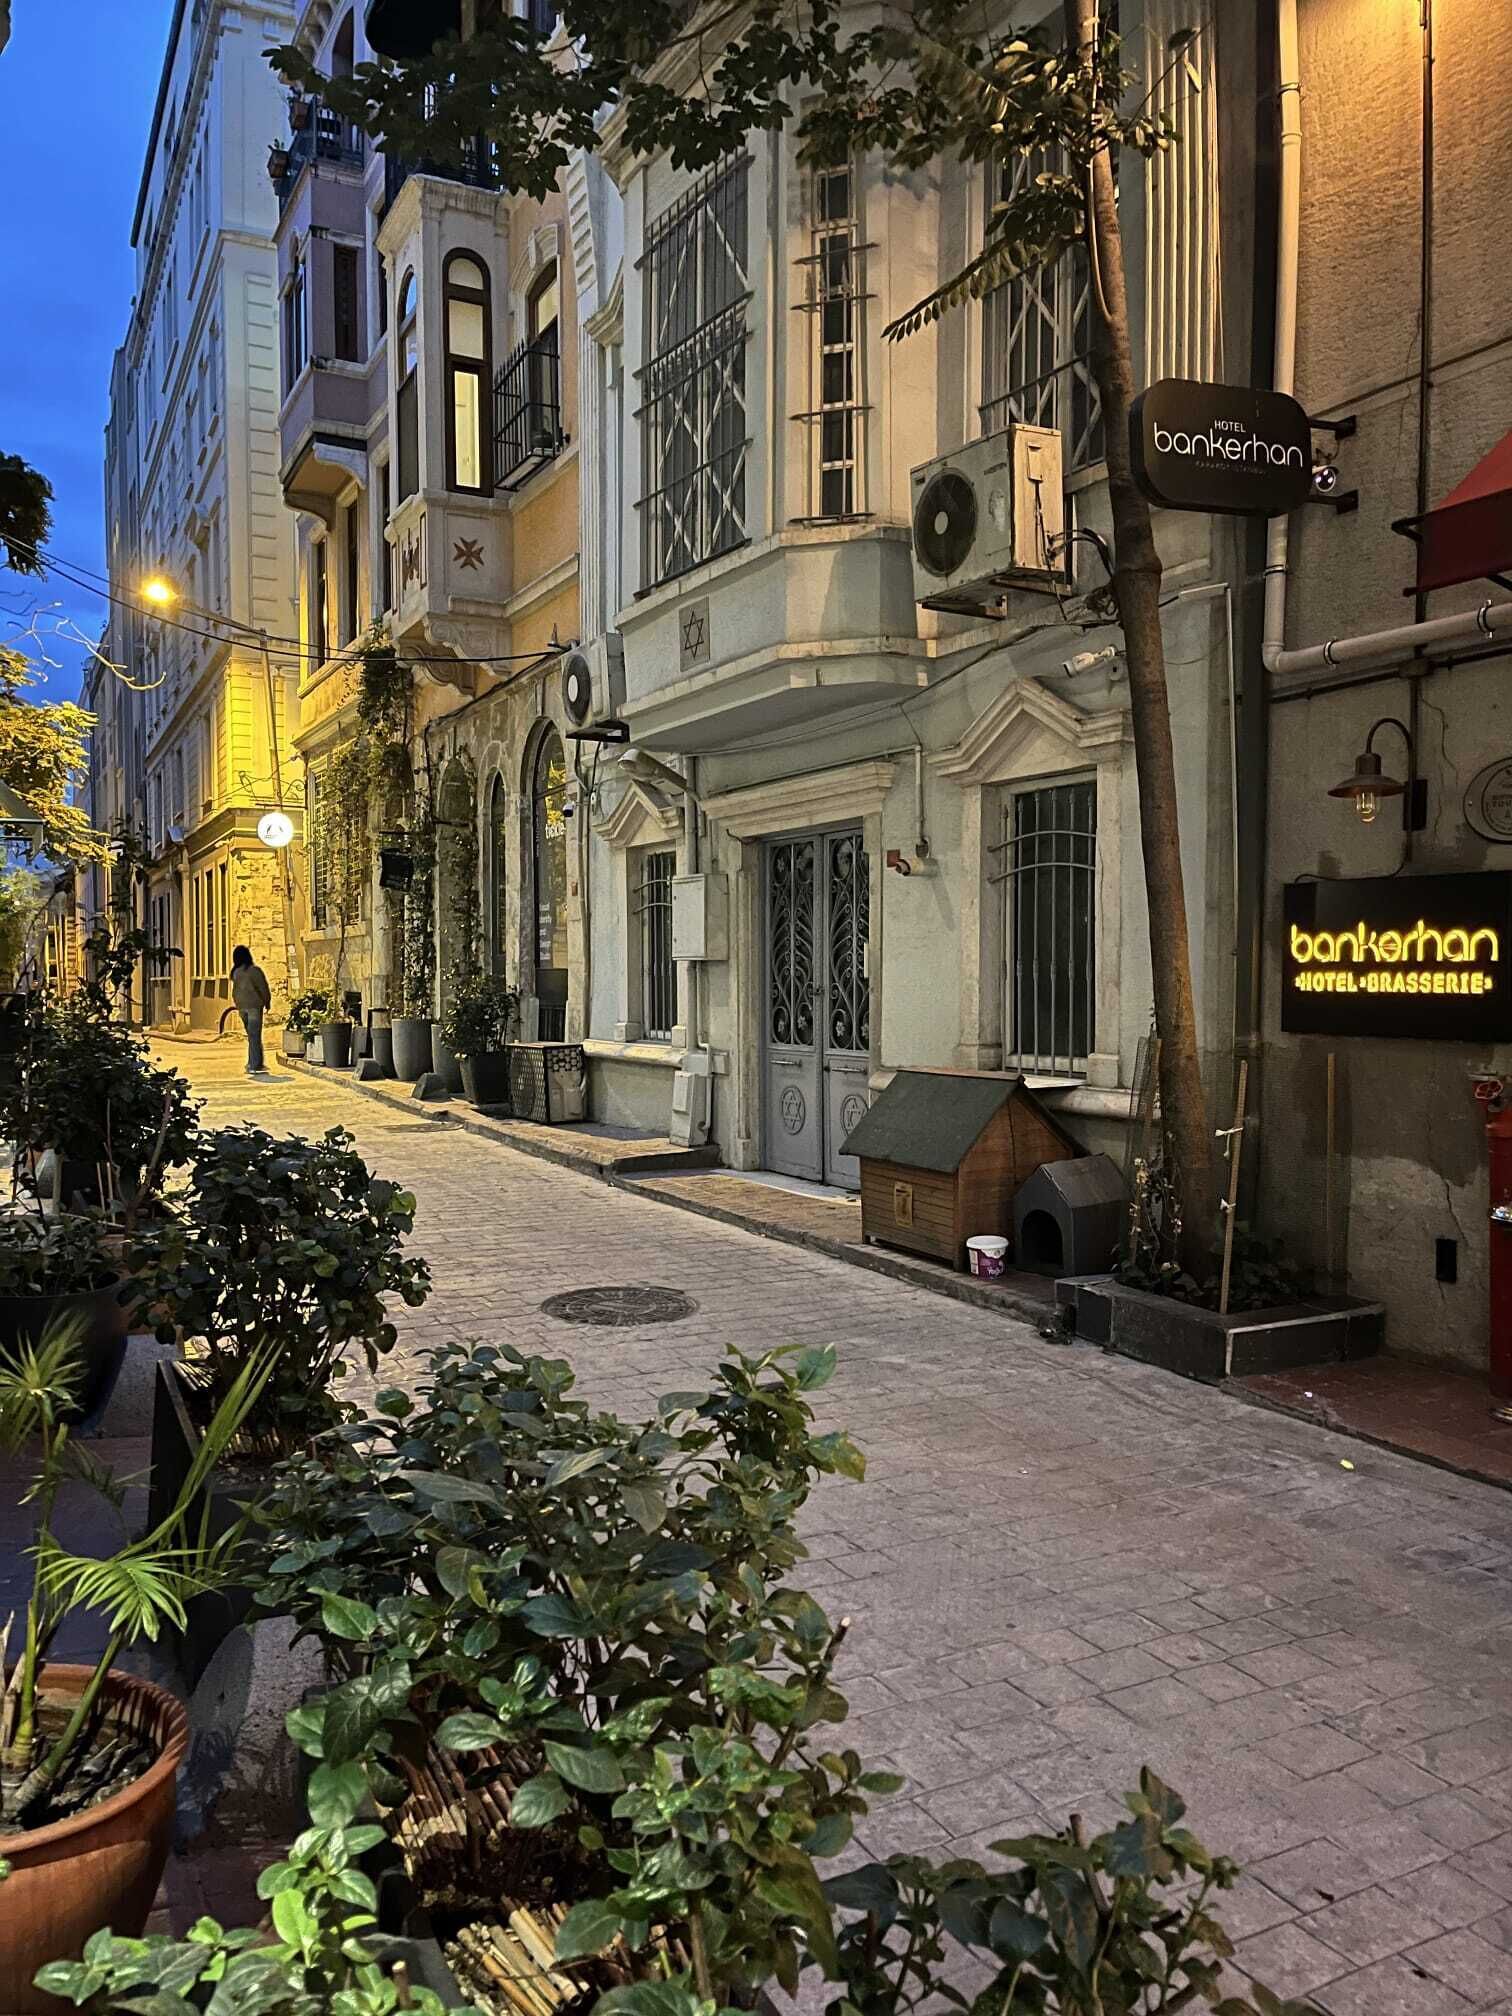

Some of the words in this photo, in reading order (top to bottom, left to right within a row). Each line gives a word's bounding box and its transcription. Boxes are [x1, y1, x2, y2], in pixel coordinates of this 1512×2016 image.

[1153, 422, 1303, 468] bankerhan
[1214, 420, 1246, 433] HOTEL
[1290, 919, 1499, 963] bankerhan
